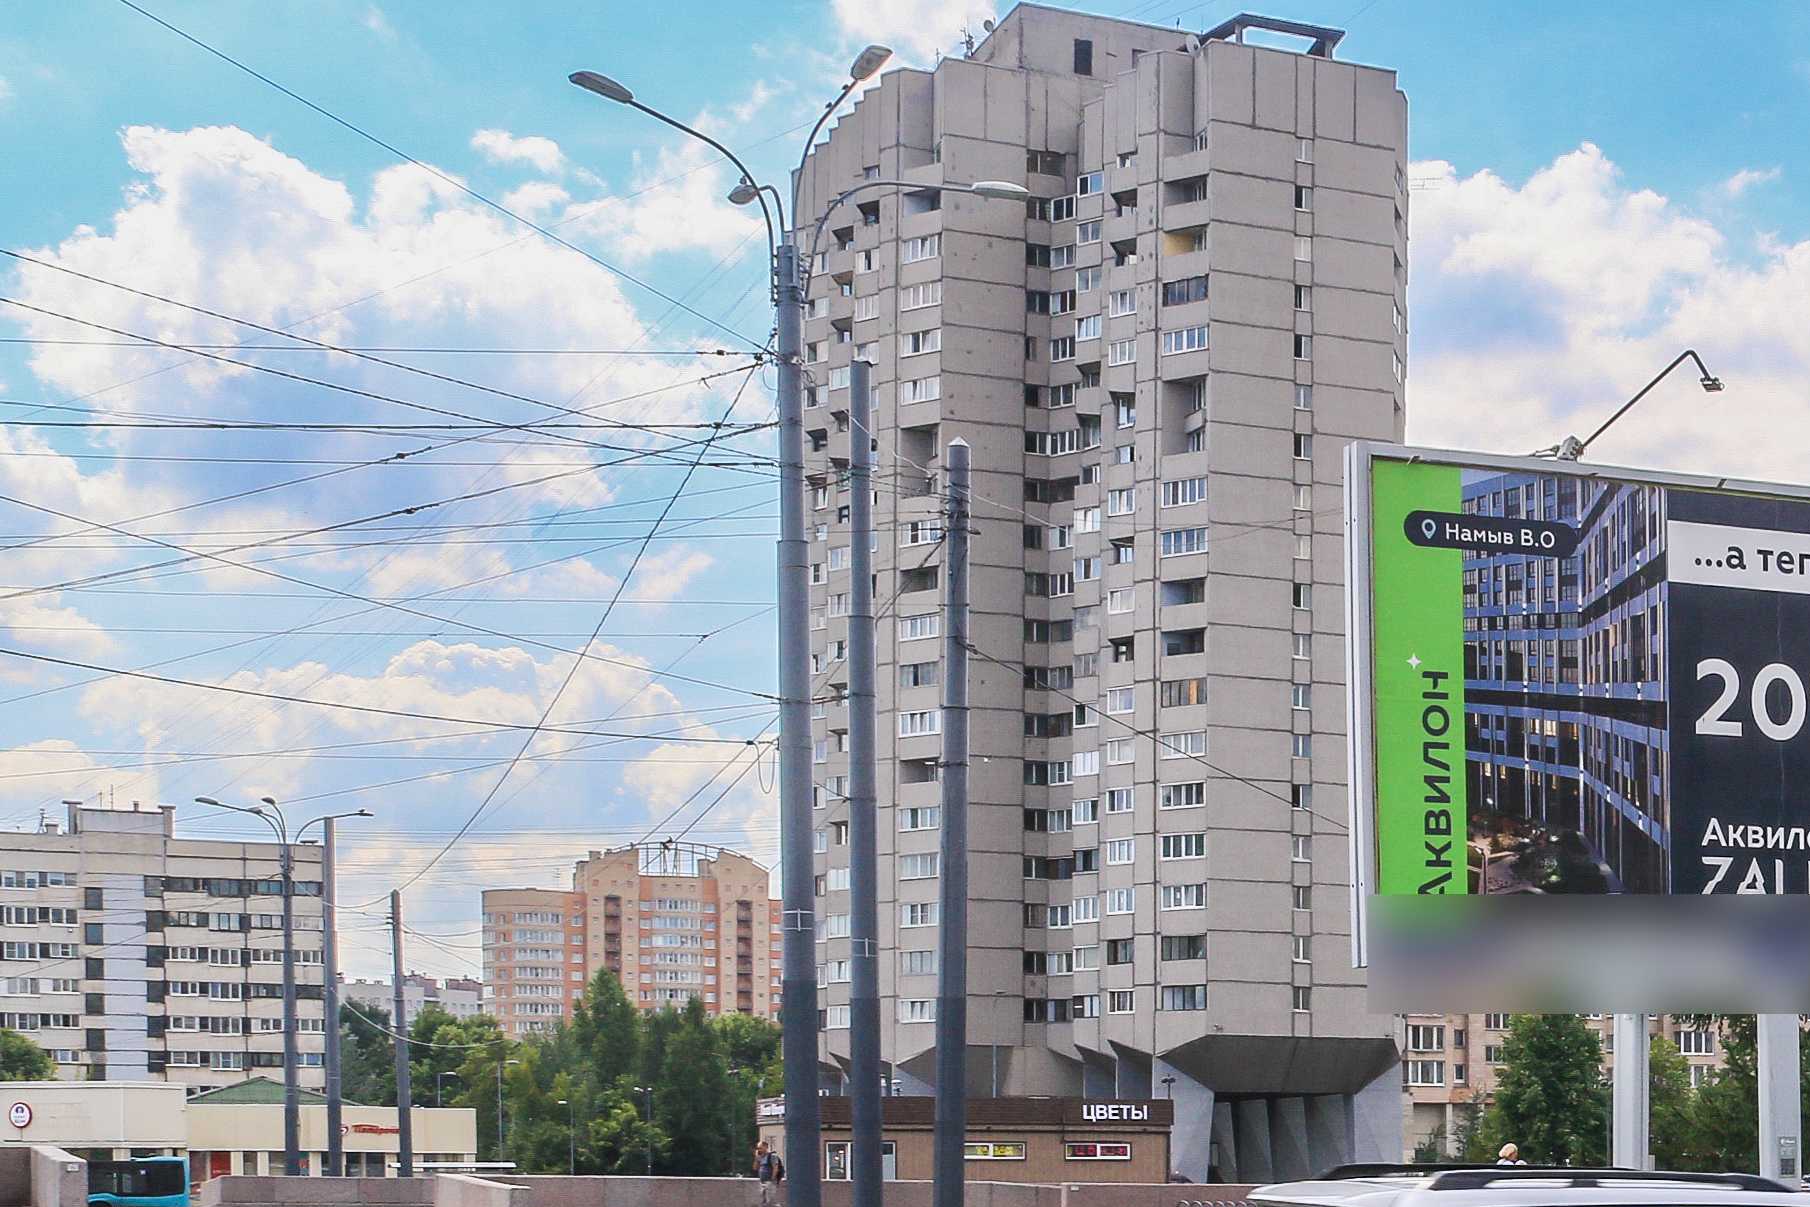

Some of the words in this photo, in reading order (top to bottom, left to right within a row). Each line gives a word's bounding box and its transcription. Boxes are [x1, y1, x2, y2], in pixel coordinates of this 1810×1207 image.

[1445, 522, 1514, 545] Намыв
[1520, 528, 1556, 549] В.О
[1082, 1104, 1148, 1122] ЦВЕТЫ
